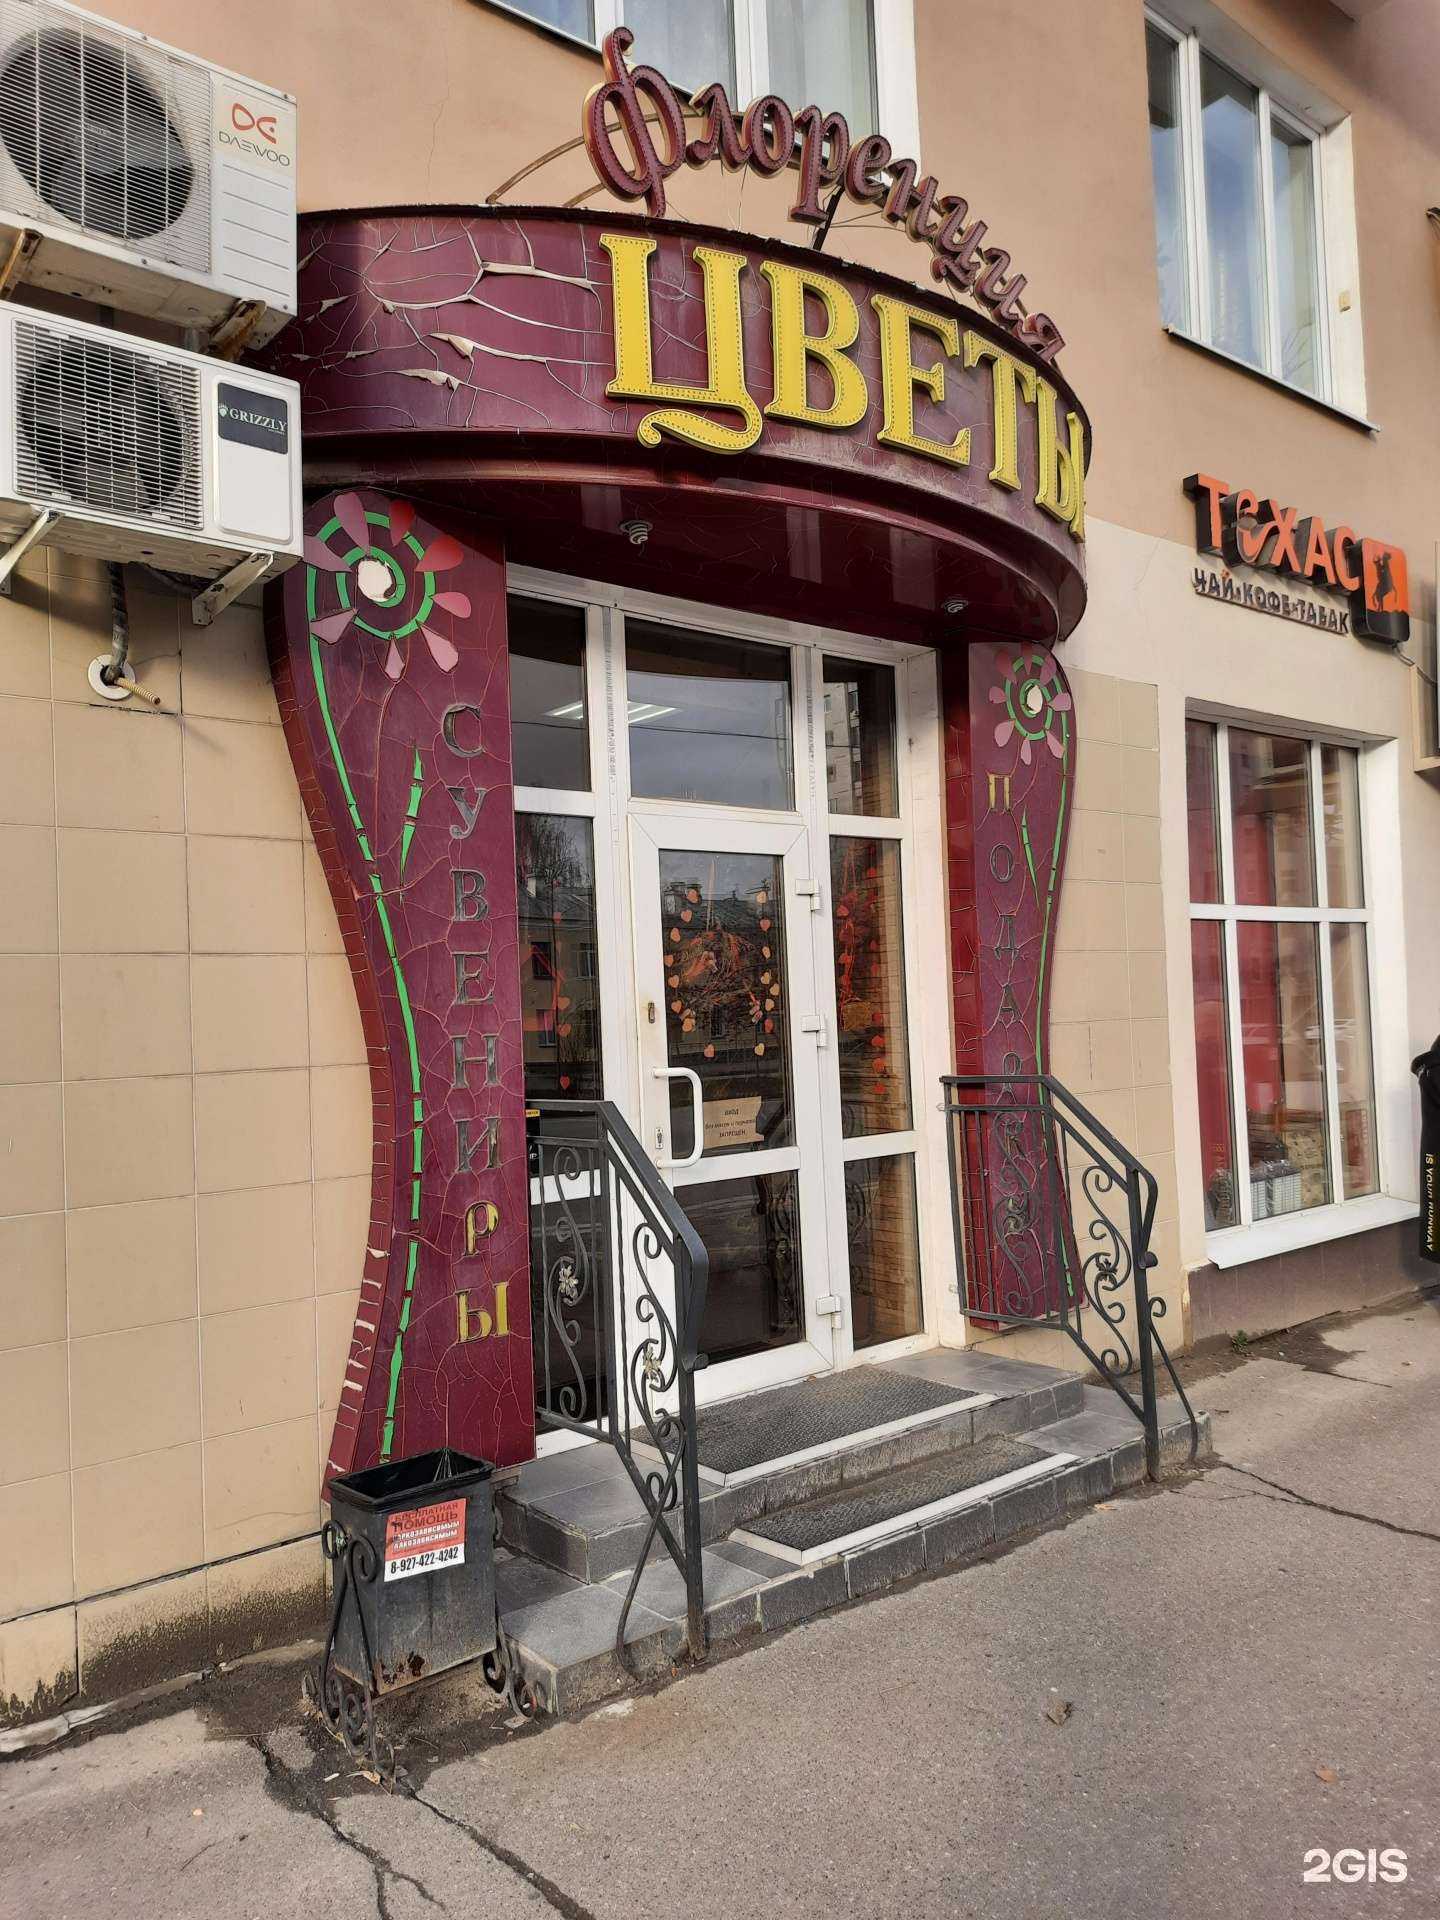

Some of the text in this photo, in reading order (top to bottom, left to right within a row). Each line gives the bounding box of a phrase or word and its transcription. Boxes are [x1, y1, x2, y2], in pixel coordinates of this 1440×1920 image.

[218, 130, 290, 167] DAEWOO
[599, 233, 1086, 543] ЦВЕТЫ
[229, 408, 287, 432] GRIZZLY
[1193, 568, 1233, 600] ЧАЙ
[1242, 582, 1290, 617] КОФЕ
[391, 1512, 458, 1532] ПОМОЩЬ
[390, 1546, 459, 1575] 8-927-422-4242
